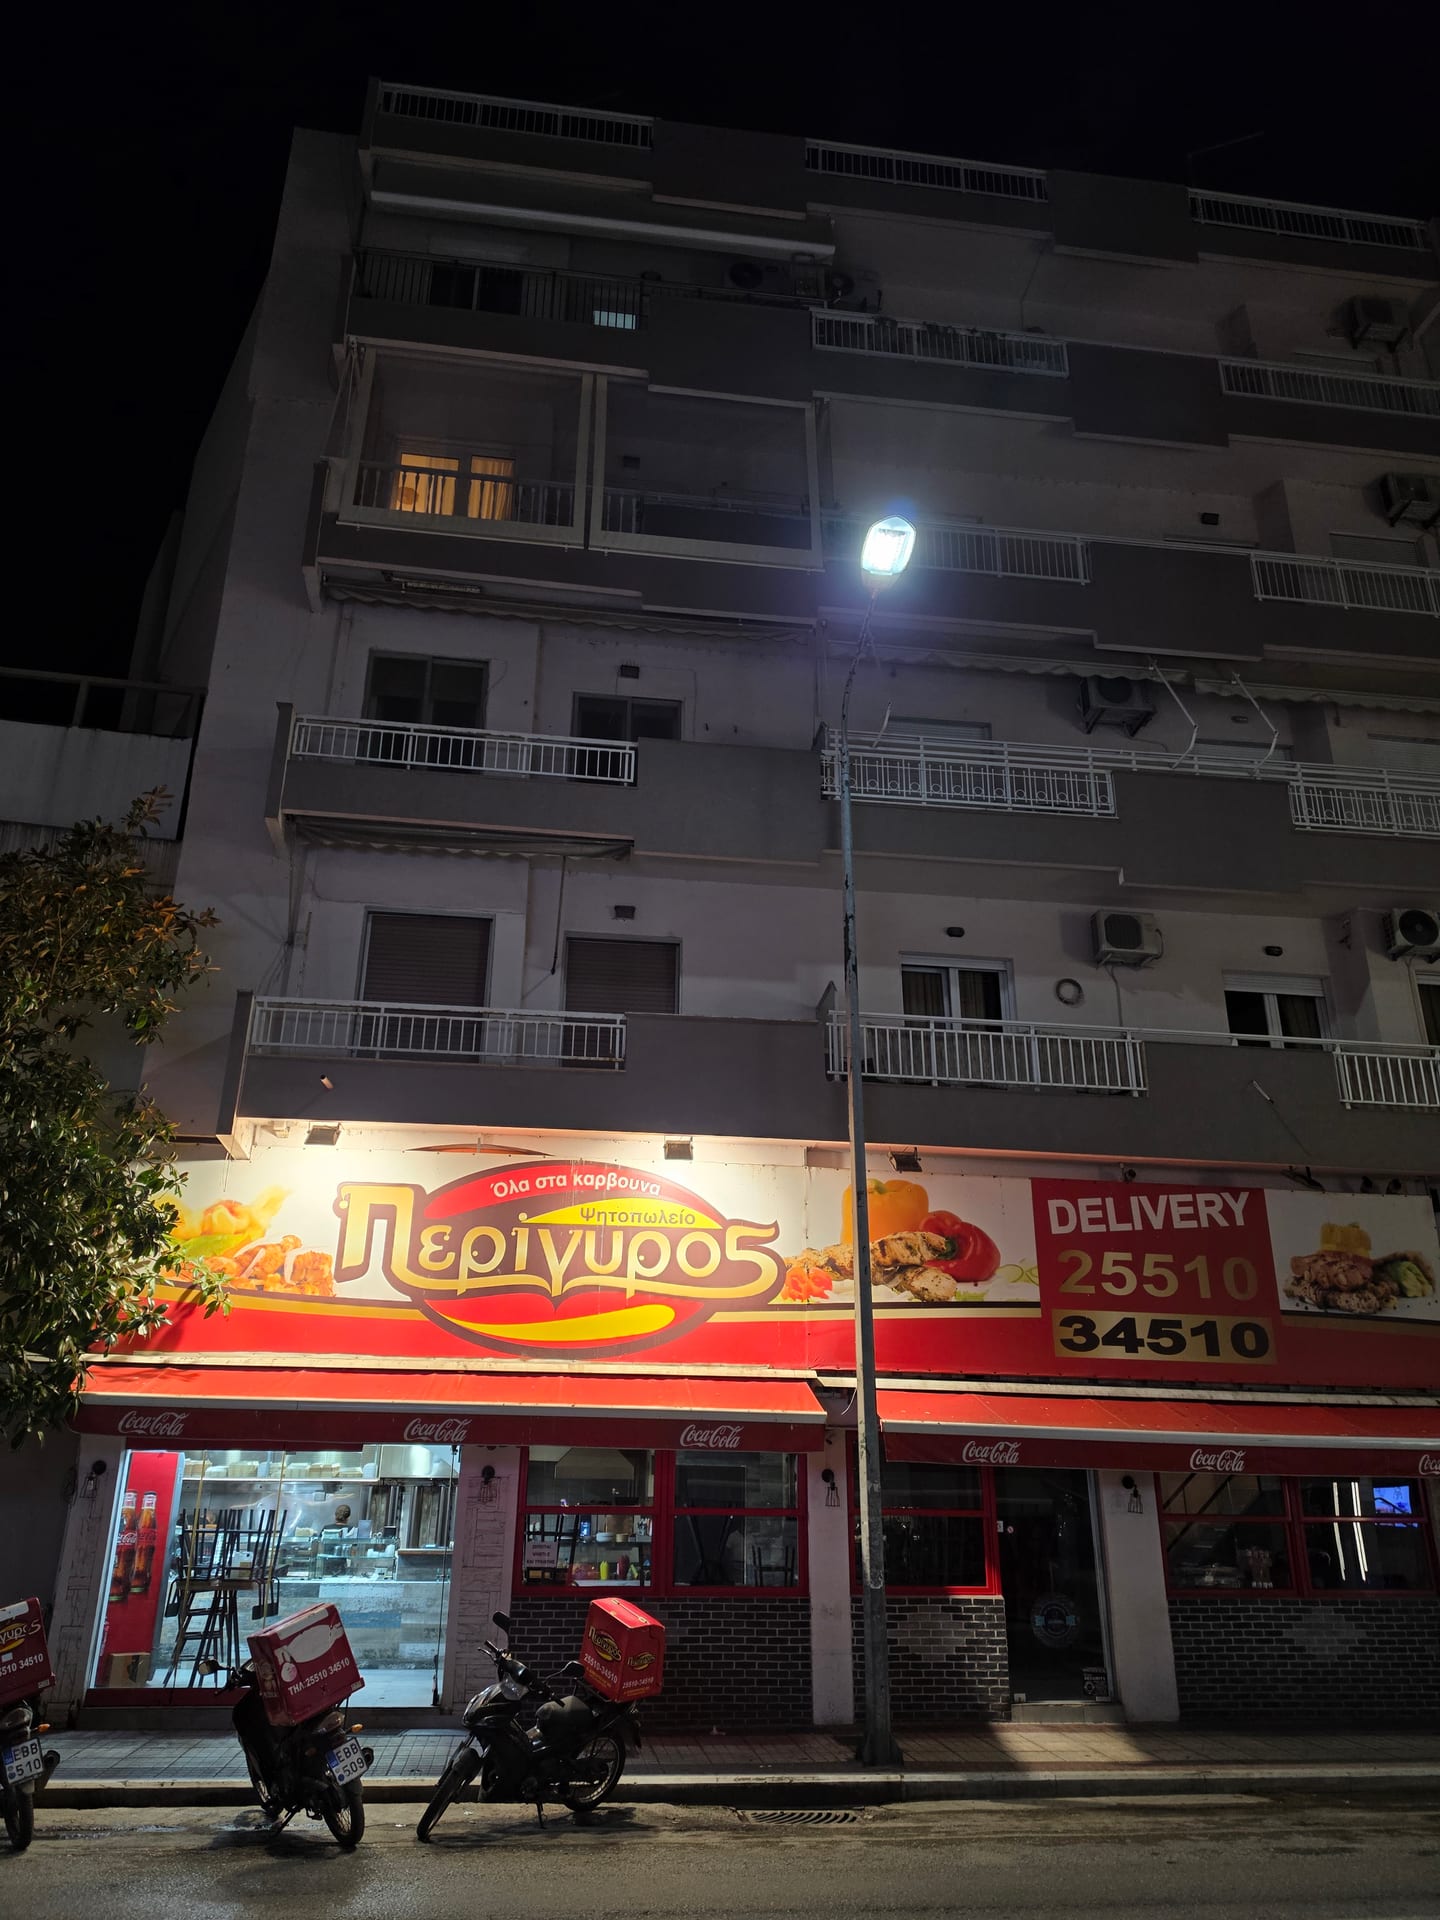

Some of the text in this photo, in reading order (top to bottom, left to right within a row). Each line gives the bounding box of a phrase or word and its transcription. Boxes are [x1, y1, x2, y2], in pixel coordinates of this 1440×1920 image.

[490, 1172, 661, 1198] Όλα στα καρβουνα
[580, 1207, 696, 1226] Ψητοπωλείο
[1047, 1191, 1250, 1235] DELIVERY
[1057, 1249, 1258, 1301] 25510
[1059, 1315, 1269, 1359] 34510
[18, 1653, 44, 1669] 34510
[328, 1657, 350, 1675] 34510
[14, 1742, 38, 1762] EBB
[336, 1743, 359, 1763] EBB
[15, 1758, 41, 1776] 510
[342, 1757, 364, 1777] 509
